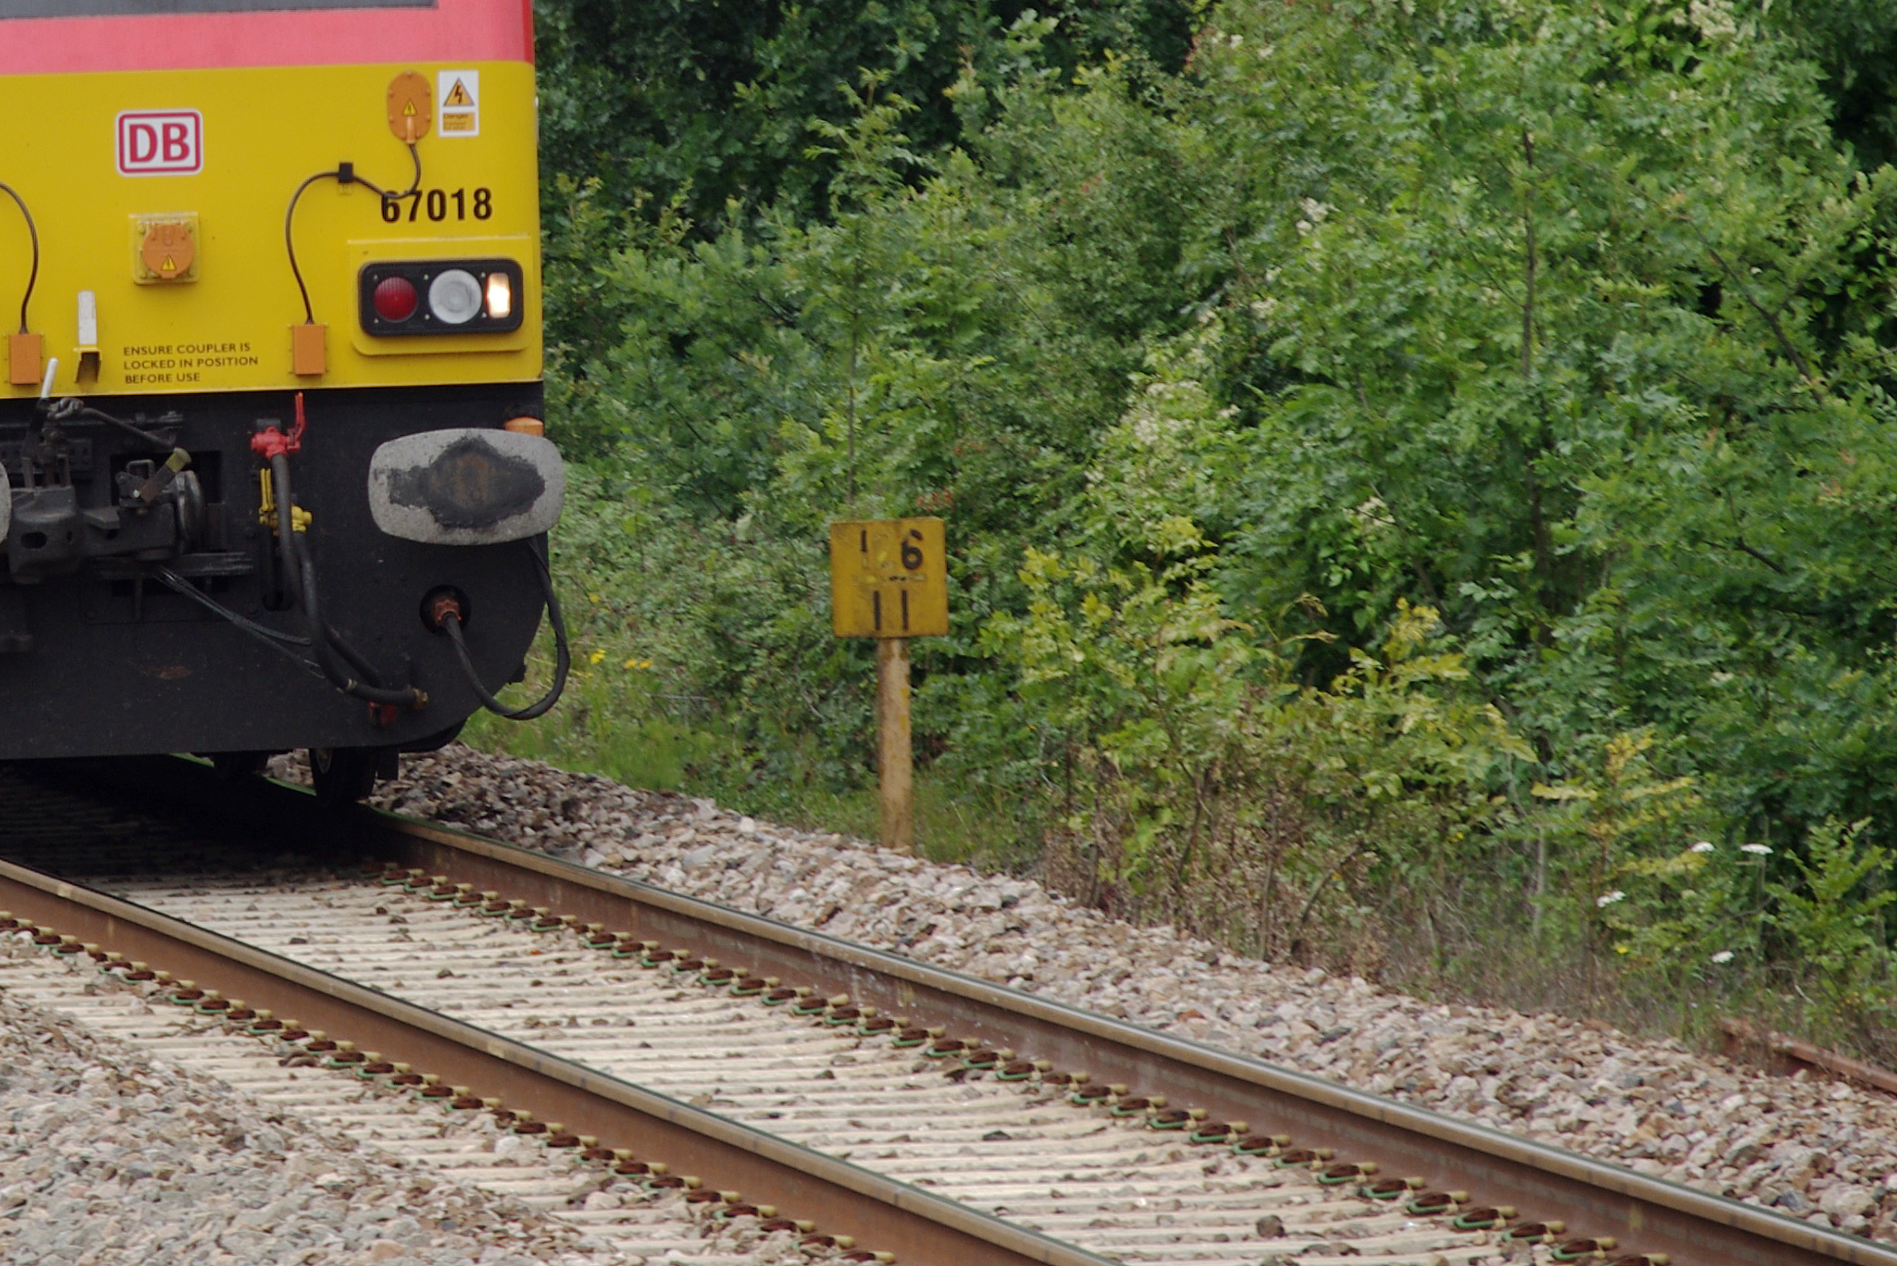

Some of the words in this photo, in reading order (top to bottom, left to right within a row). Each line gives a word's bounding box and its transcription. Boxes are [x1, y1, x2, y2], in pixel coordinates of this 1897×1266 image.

[129, 123, 190, 162] DB
[381, 187, 493, 223] 67018
[123, 345, 173, 356] ENSURE
[176, 343, 237, 354] COUPLER
[239, 342, 251, 352] IS
[123, 359, 176, 370] LOCKED
[179, 358, 193, 368] IN
[197, 356, 259, 367] POSITION
[125, 373, 172, 384] BEFORE
[176, 372, 200, 382] USE
